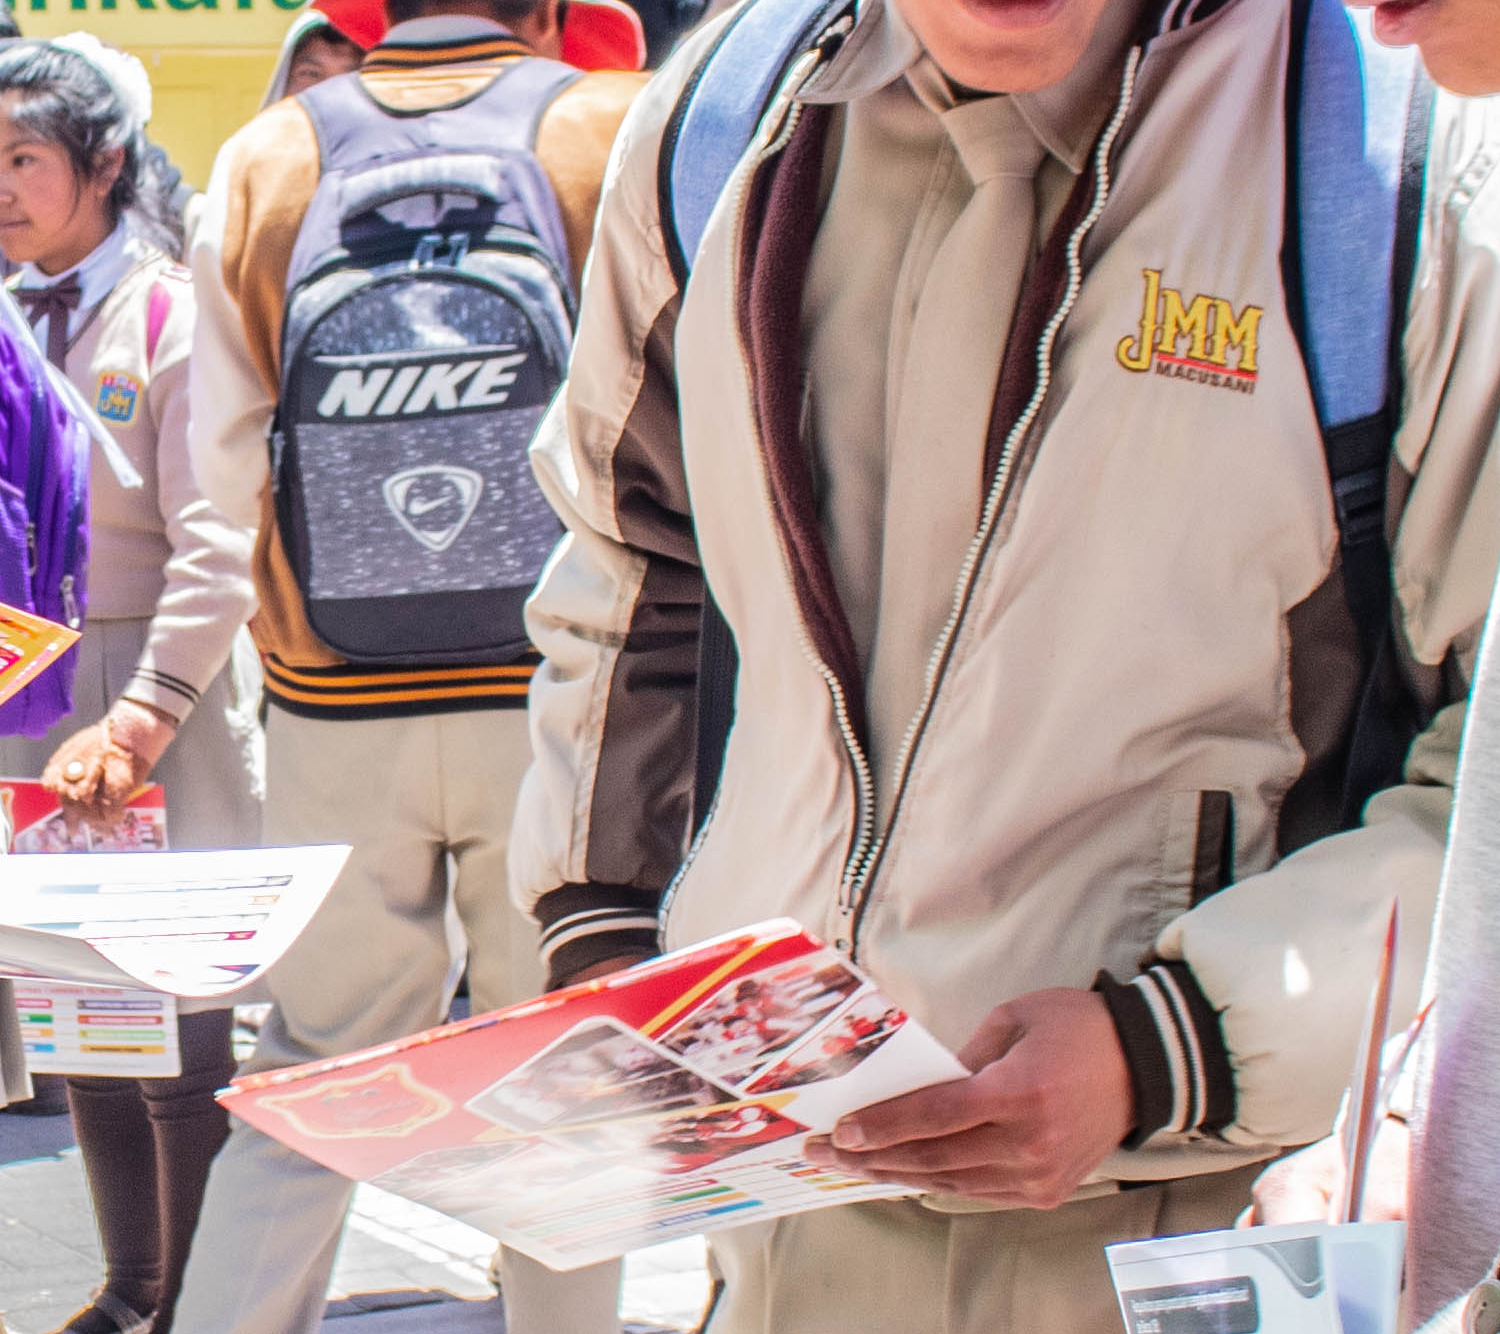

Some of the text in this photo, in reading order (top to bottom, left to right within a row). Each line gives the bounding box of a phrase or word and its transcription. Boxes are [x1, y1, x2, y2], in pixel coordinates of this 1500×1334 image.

[1116, 268, 1265, 373] JMM
[316, 352, 528, 418] NIKE
[1155, 361, 1257, 395] MACUSANI
